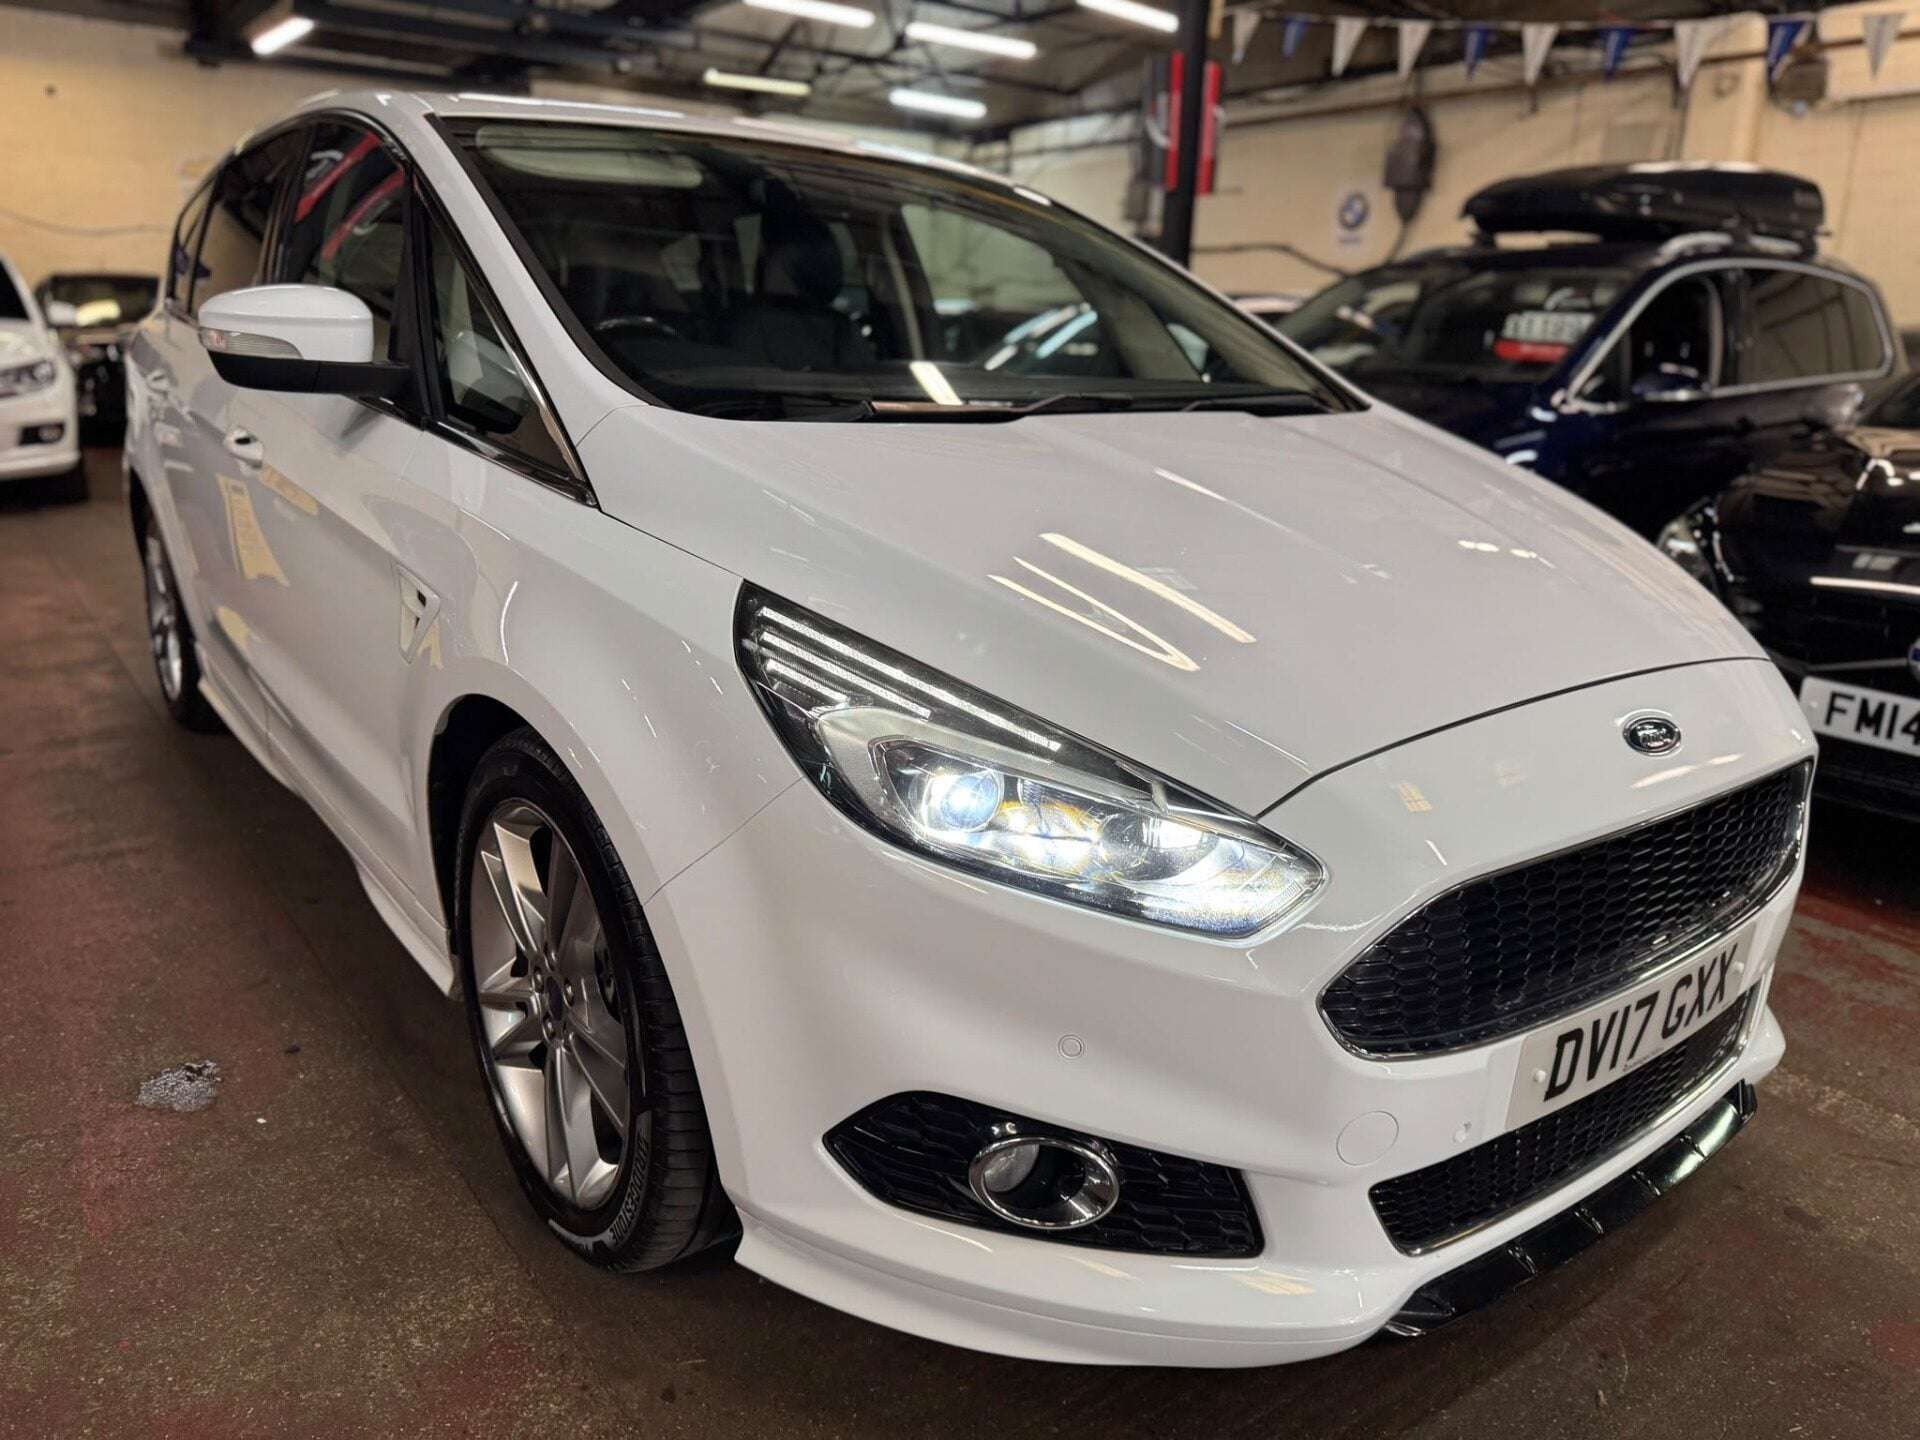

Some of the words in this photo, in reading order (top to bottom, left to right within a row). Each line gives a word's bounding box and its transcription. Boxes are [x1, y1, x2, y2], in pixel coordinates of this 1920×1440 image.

[1824, 691, 1920, 745] FM14
[1544, 990, 1660, 1102] DV17
[1661, 943, 1738, 1039] GXX
